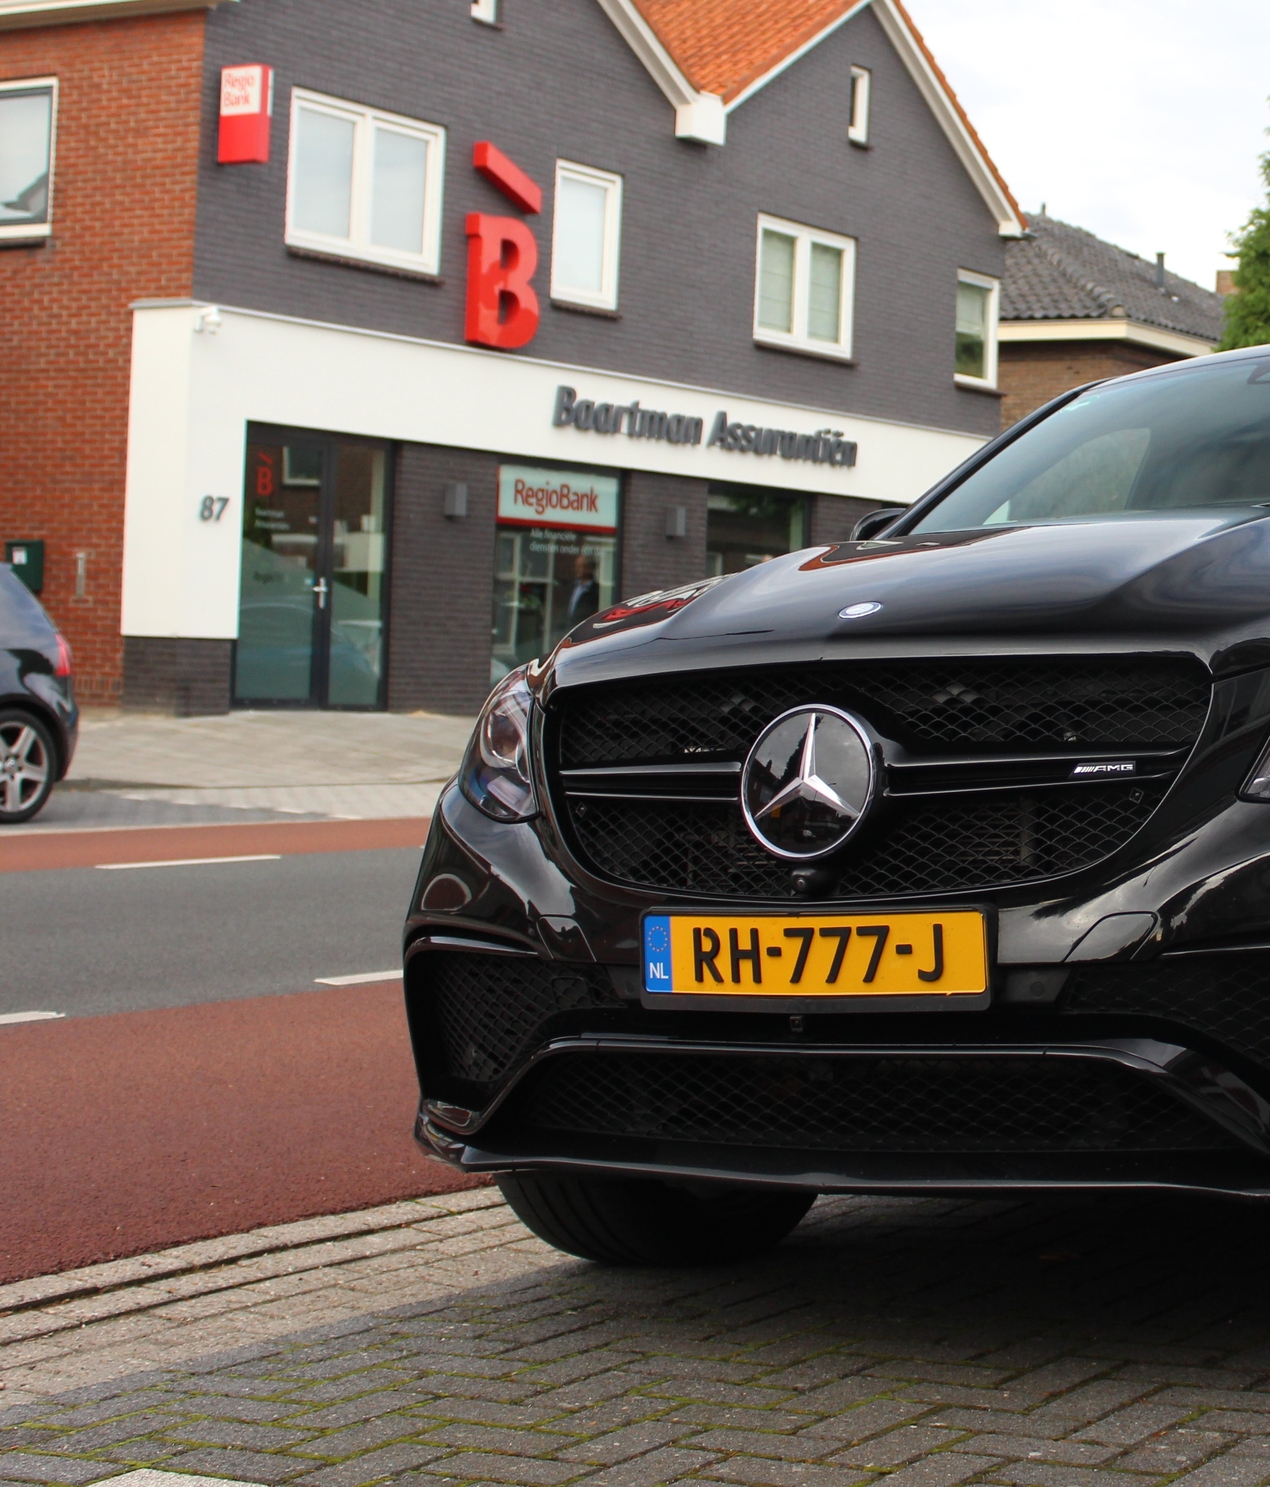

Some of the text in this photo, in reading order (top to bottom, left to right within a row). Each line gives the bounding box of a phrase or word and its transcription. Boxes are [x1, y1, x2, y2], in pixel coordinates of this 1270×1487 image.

[224, 73, 255, 92] Regio
[223, 91, 250, 107] Bank
[552, 385, 857, 468] Baartman Assurantiën
[200, 495, 230, 521] 87
[514, 478, 599, 515] RegioBank
[692, 923, 944, 984] RH-777-J
[649, 962, 669, 979] NL
